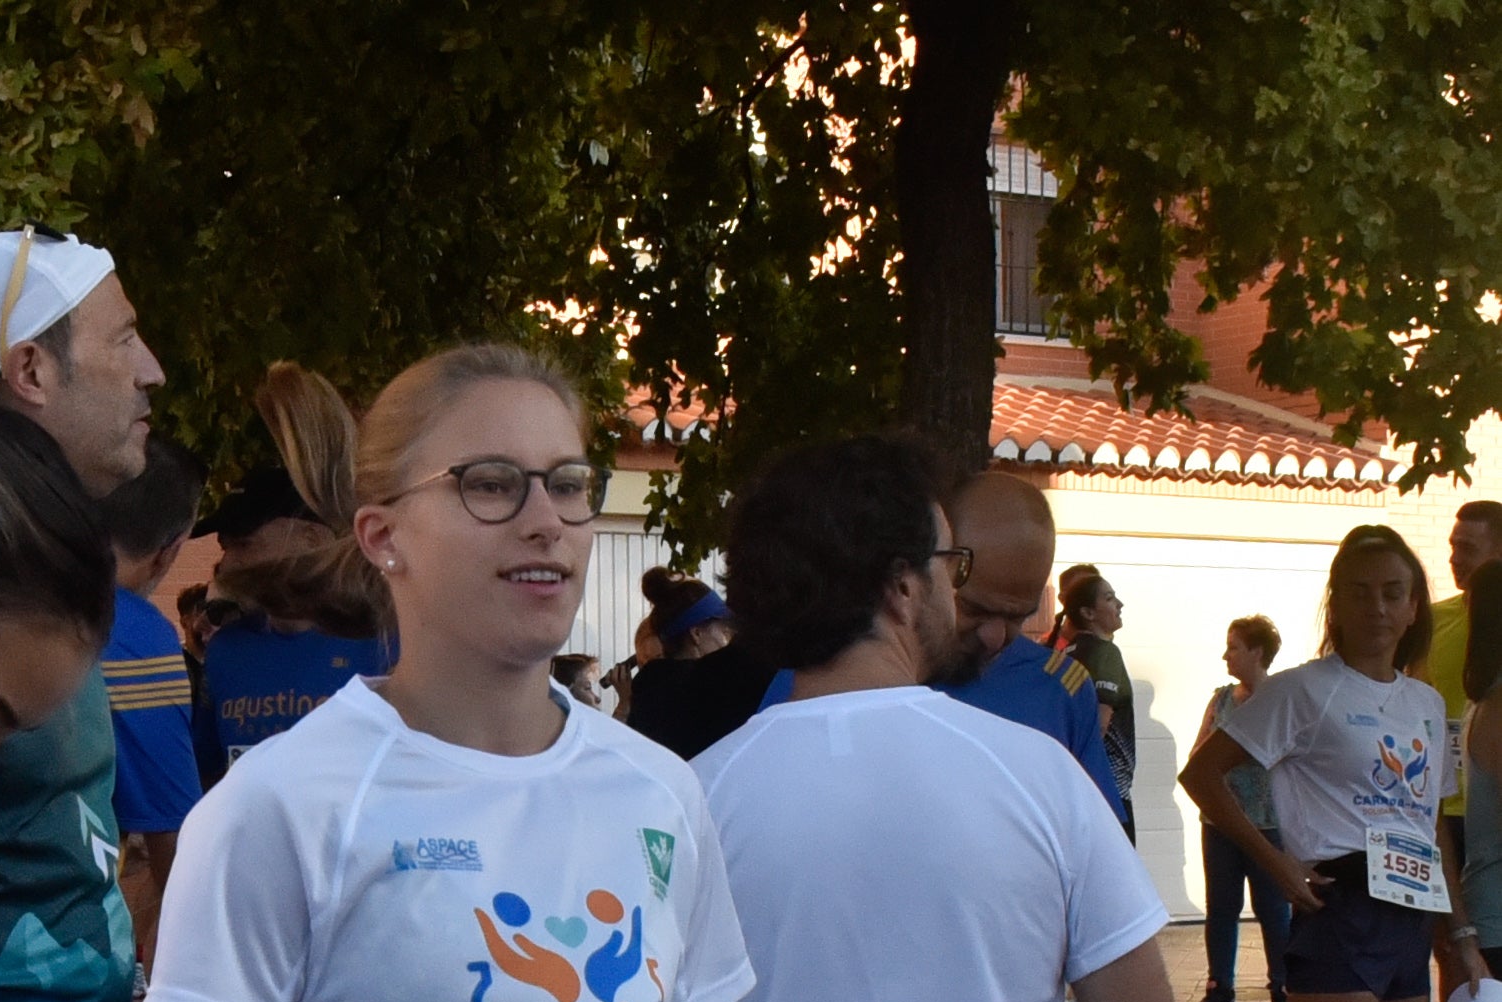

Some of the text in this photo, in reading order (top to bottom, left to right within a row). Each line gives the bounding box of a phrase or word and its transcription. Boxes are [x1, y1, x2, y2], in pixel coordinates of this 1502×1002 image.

[222, 689, 329, 727] agustin
[417, 837, 479, 860] ASPACE
[1383, 853, 1431, 882] 1535
